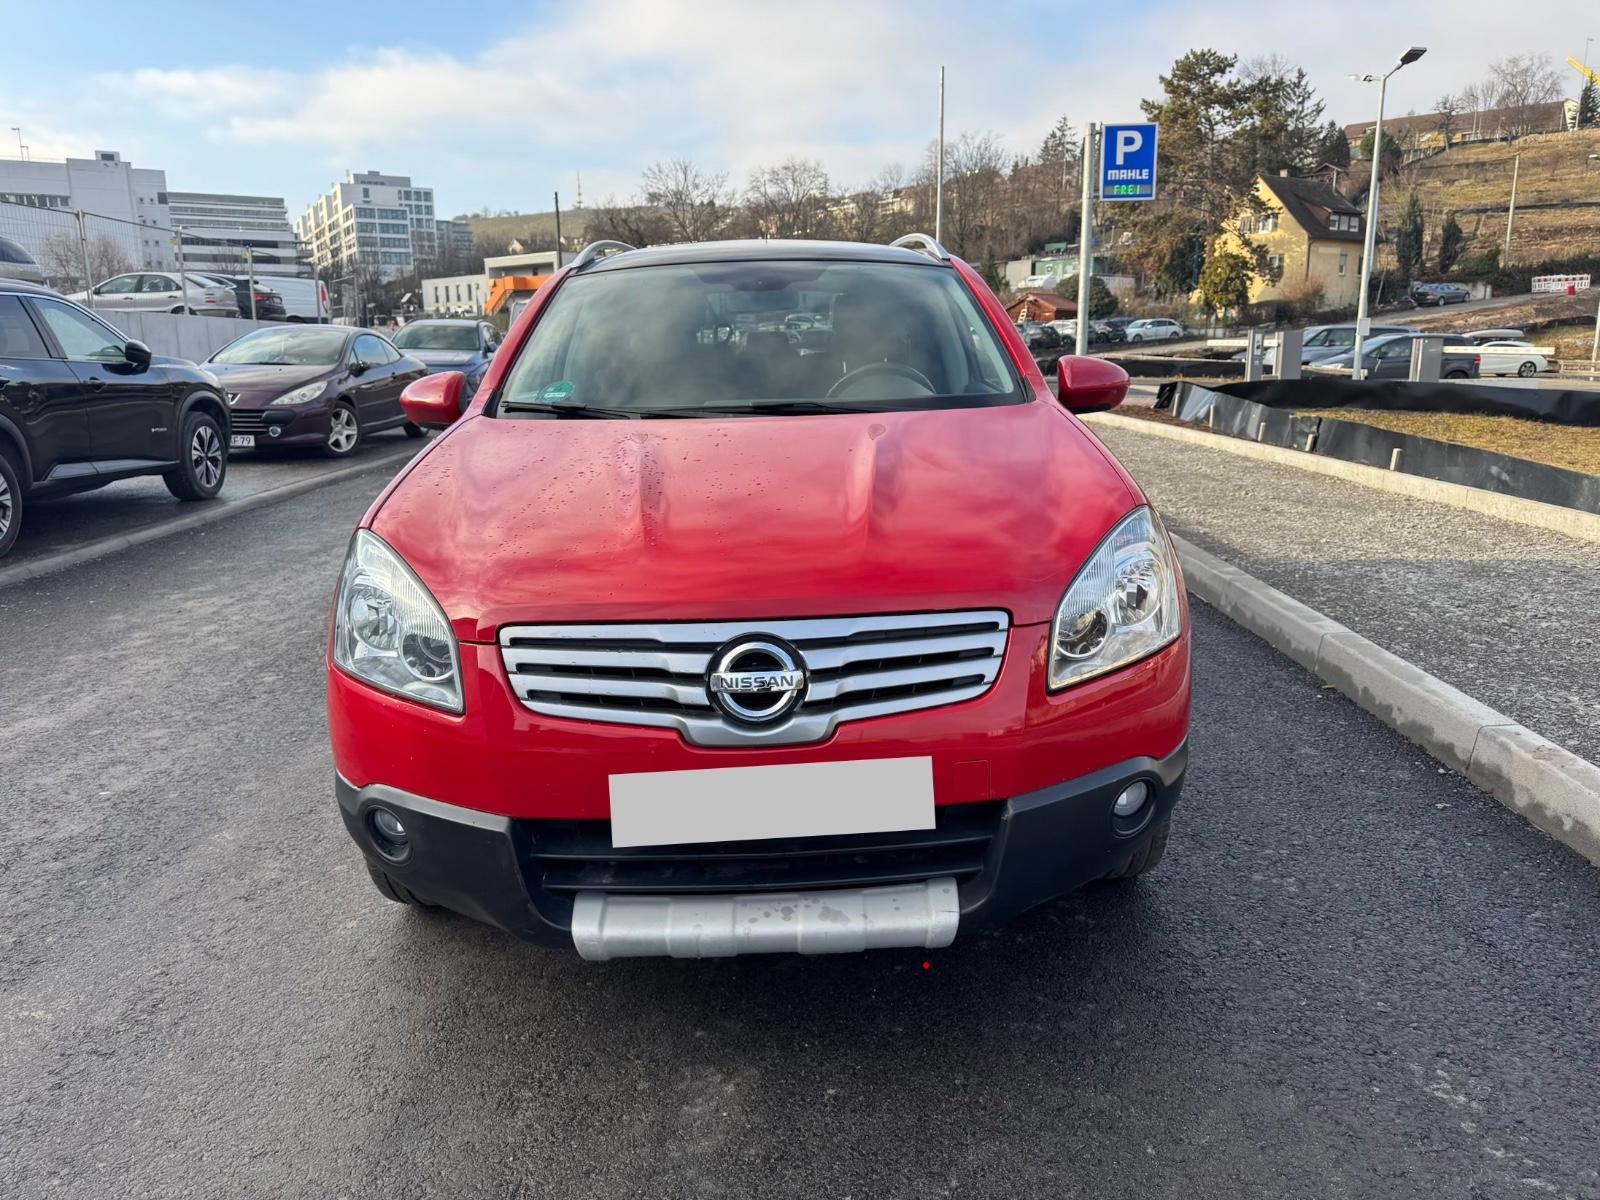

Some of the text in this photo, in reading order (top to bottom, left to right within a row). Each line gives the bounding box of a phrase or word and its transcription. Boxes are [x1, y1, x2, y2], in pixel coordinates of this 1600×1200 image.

[1115, 130, 1143, 166] P
[1107, 168, 1150, 181] MAHLE
[1112, 184, 1141, 196] FREI
[720, 675, 794, 689] NISSAN
